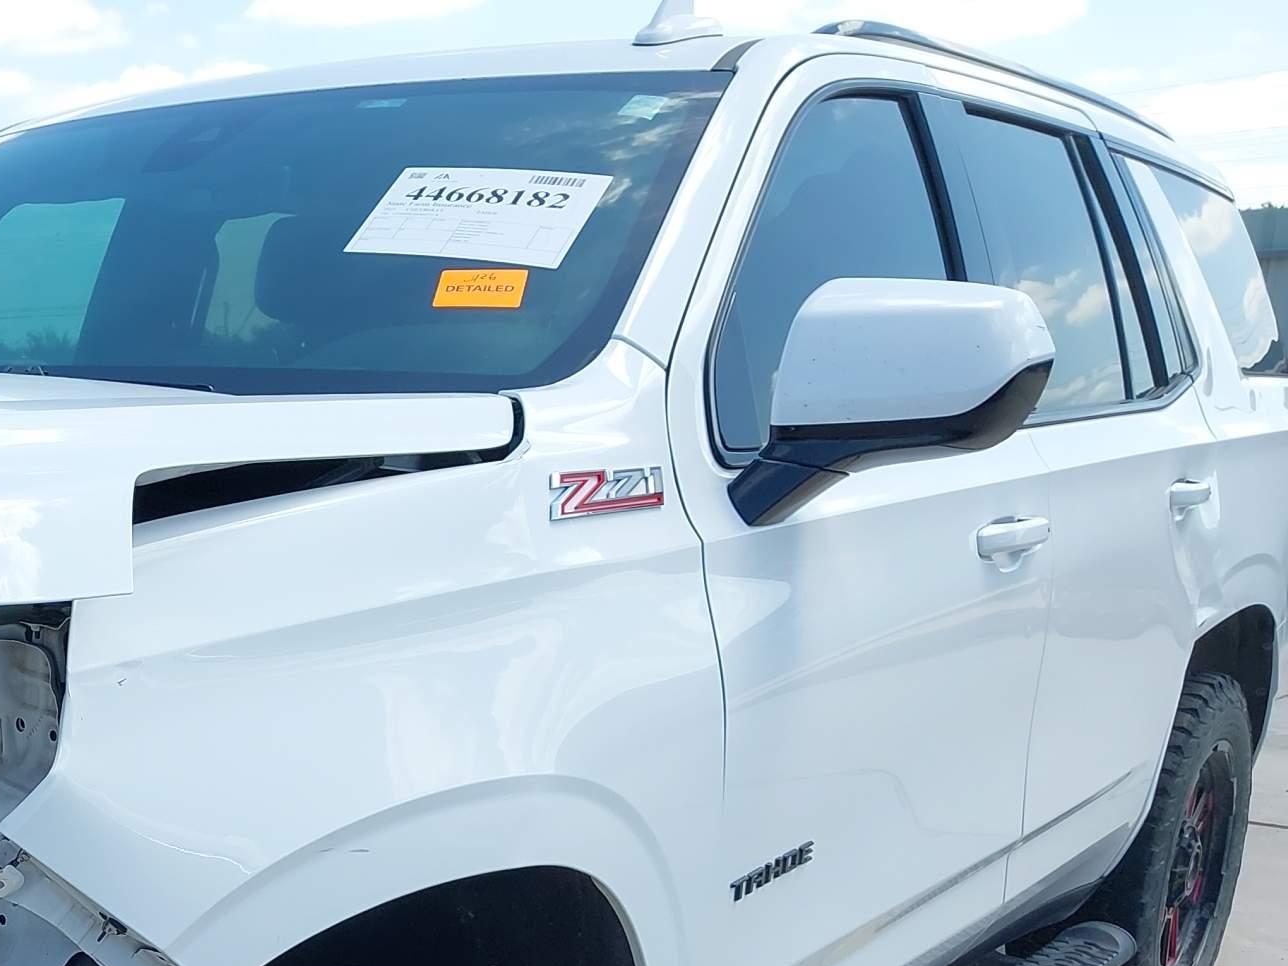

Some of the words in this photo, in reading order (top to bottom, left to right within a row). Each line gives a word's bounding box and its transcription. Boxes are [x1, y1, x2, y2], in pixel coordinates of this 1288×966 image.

[405, 186, 570, 210] 44668182
[445, 285, 515, 293] DETAILED
[549, 466, 664, 521] Z71
[730, 840, 815, 902] TAHOE
